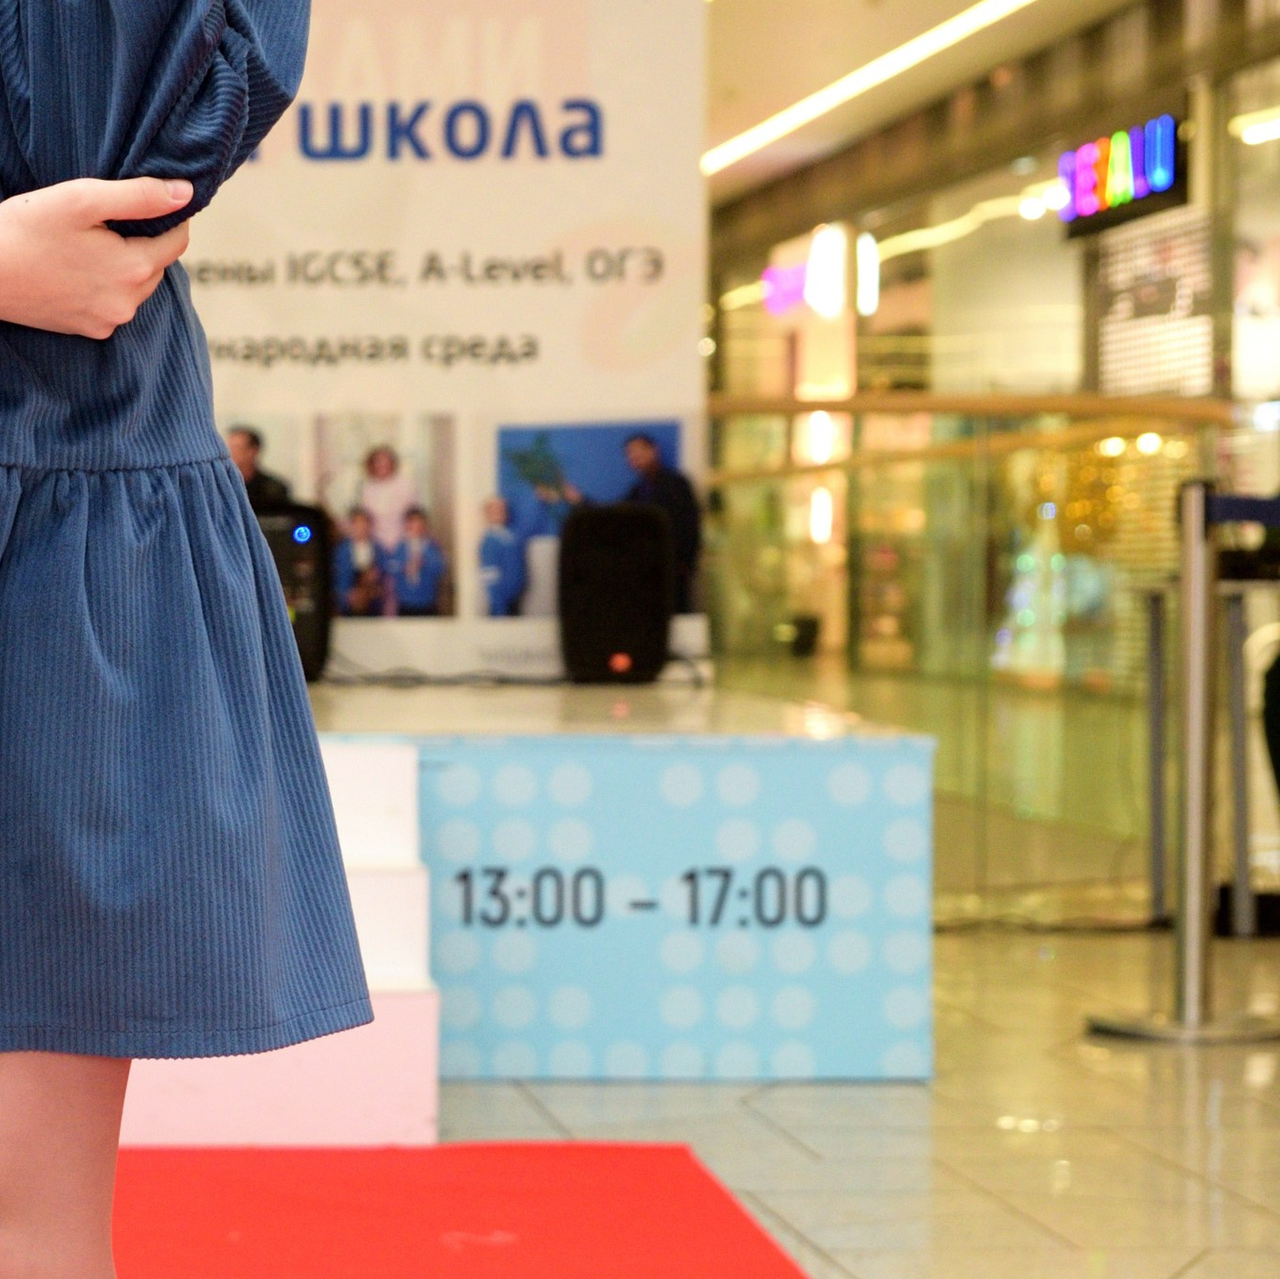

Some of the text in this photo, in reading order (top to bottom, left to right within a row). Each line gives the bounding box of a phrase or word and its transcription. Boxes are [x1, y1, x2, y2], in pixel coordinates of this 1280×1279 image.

[297, 98, 605, 161] школа
[187, 260, 276, 286] ены
[585, 246, 665, 285] ОГЭ
[209, 335, 409, 369] народная
[419, 333, 539, 371] среда
[455, 864, 605, 928] 13:00
[681, 864, 828, 928] 17:00
